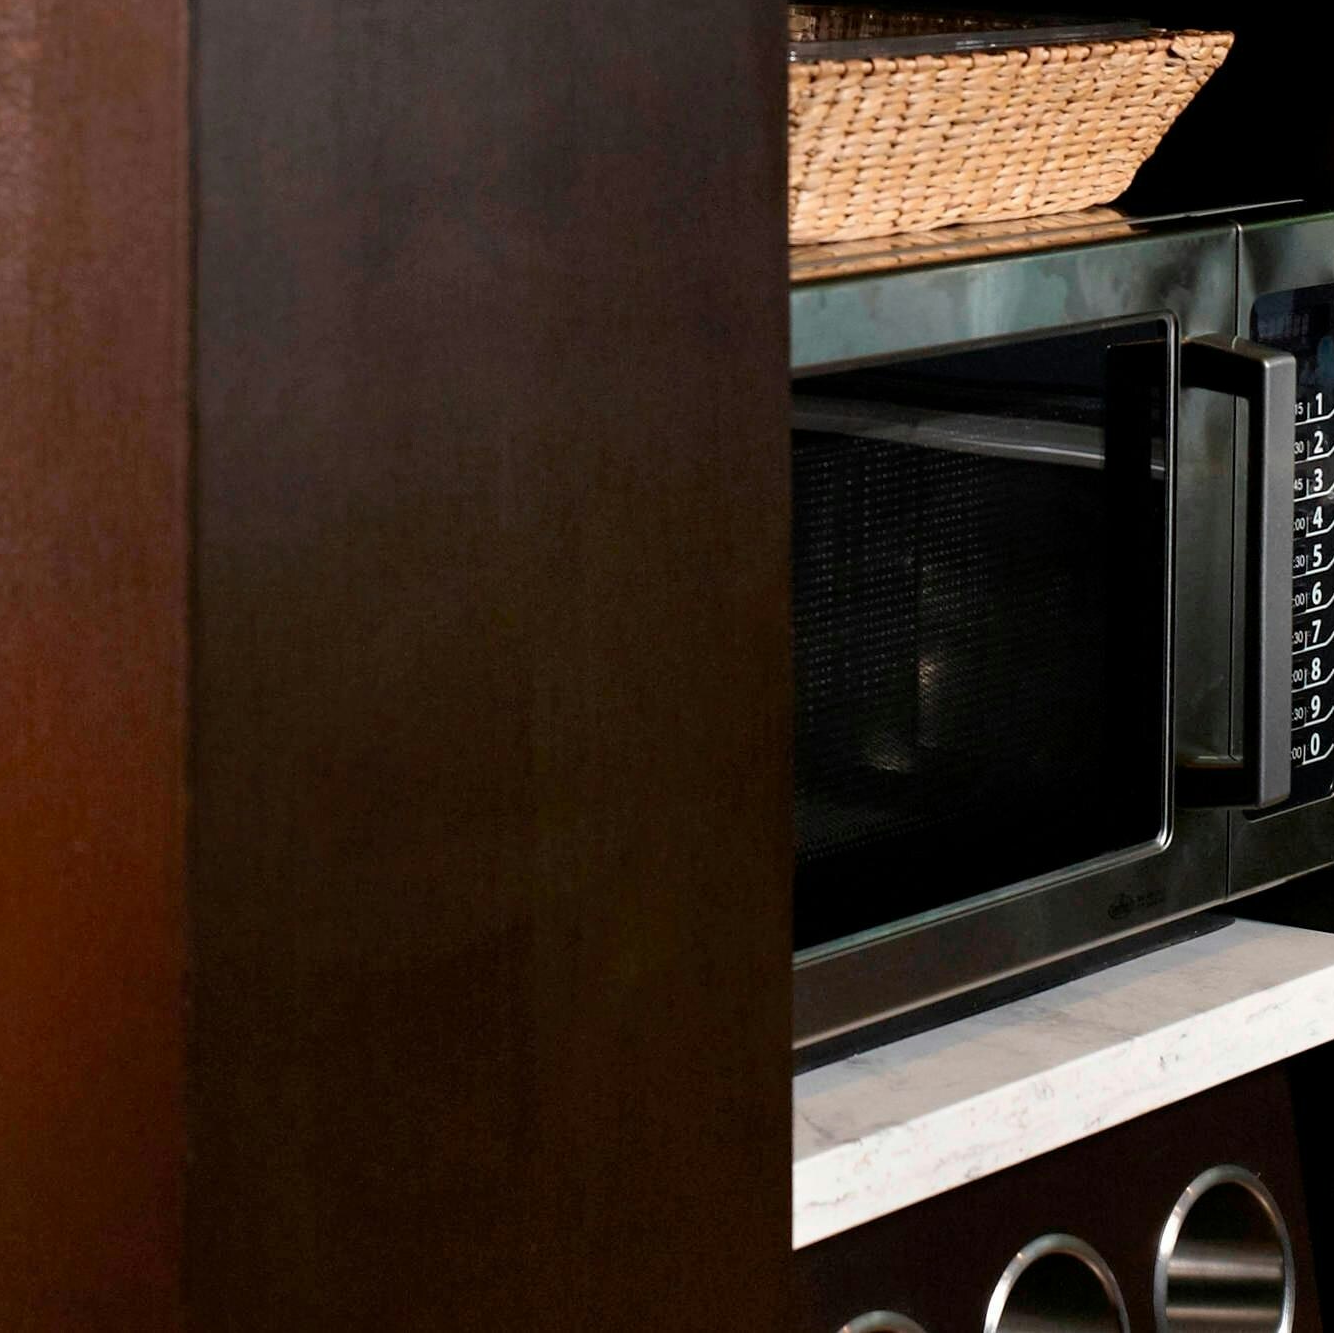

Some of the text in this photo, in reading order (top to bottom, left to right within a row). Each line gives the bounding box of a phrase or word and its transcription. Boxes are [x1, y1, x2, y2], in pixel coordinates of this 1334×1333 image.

[1315, 392, 1323, 415] 1
[1314, 431, 1324, 454] 2
[1314, 468, 1323, 492] 3
[1312, 506, 1323, 529] 4
[1313, 544, 1322, 568] 5
[1312, 582, 1322, 605] 6
[1312, 619, 1322, 644] 7
[1311, 657, 1321, 681] 8
[1311, 695, 1320, 719] 9
[1310, 733, 1320, 756] 0
